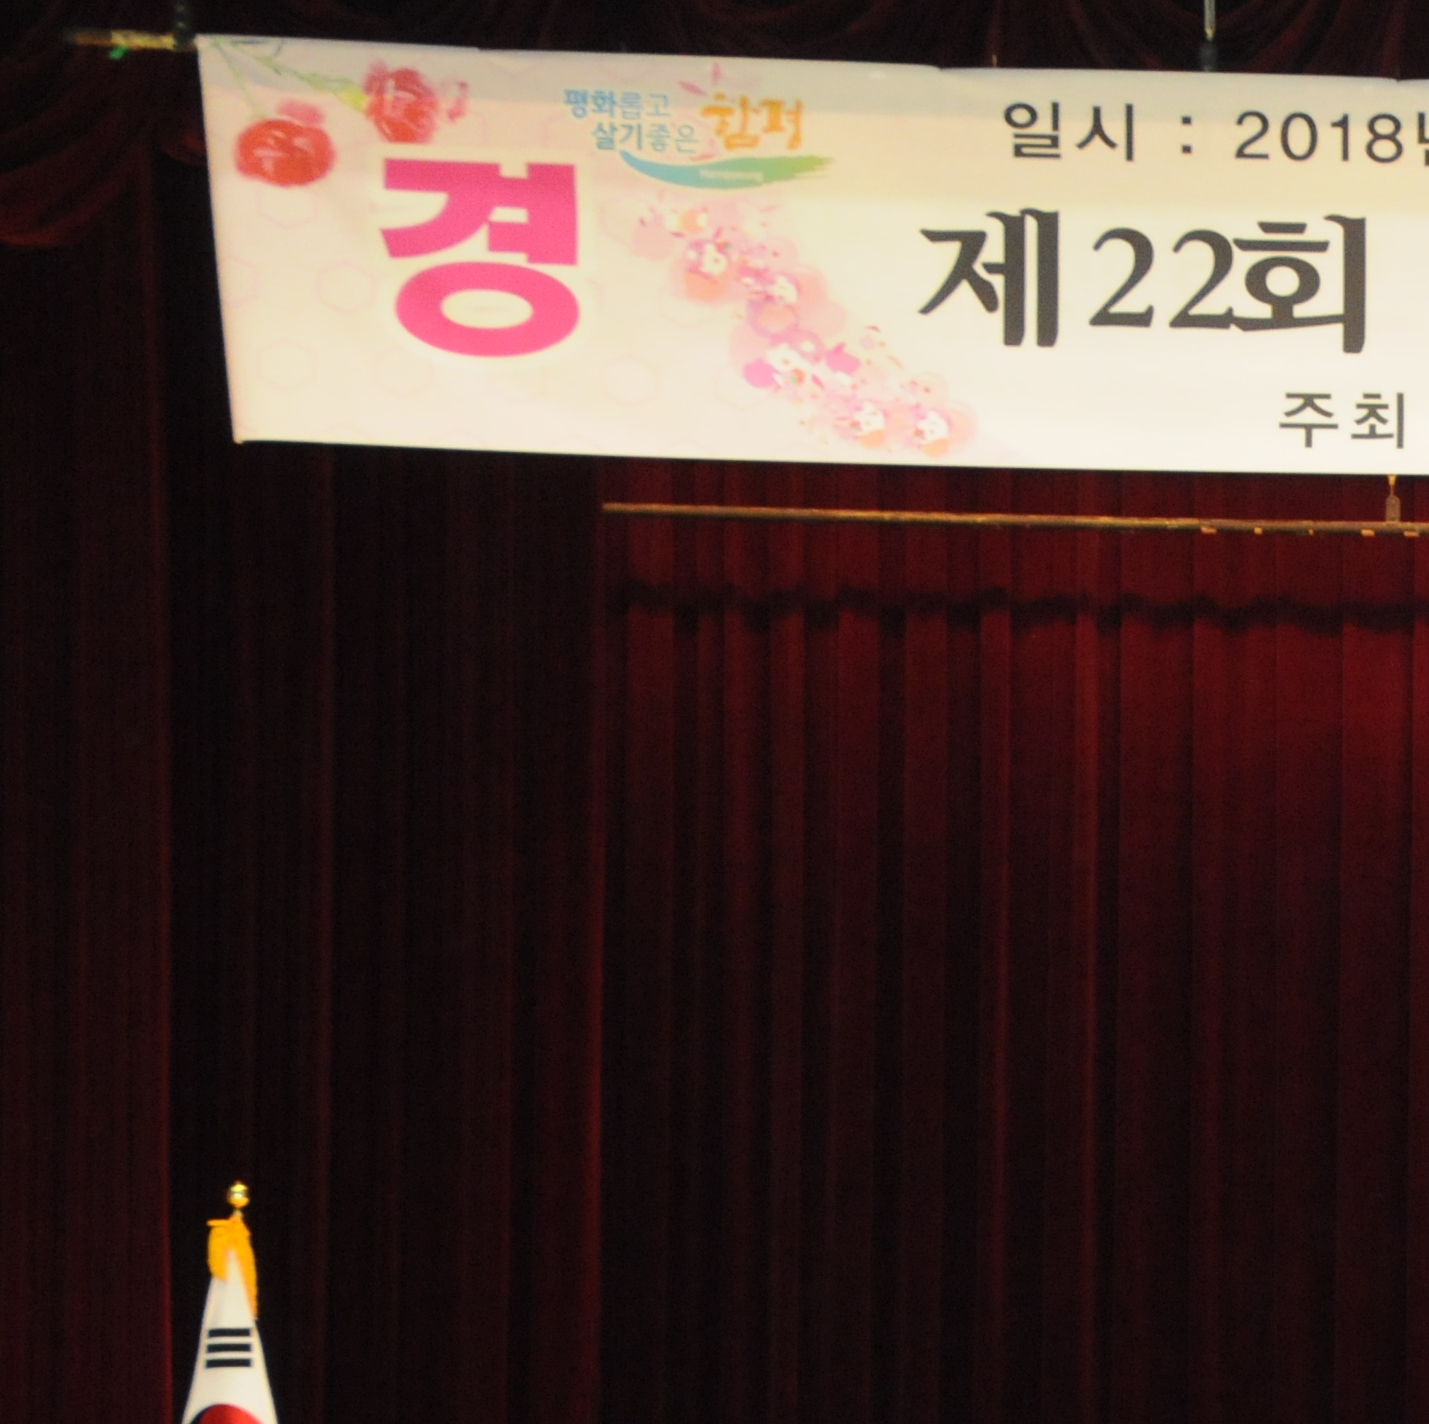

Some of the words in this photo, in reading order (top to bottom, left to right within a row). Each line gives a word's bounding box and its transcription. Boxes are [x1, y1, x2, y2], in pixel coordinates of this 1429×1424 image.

[564, 89, 671, 119] 평화롭고
[1004, 102, 1133, 161] 일시
[592, 122, 699, 153] 살기좋은
[382, 158, 578, 356] 경
[919, 208, 1366, 353] 제22회
[1280, 393, 1404, 448] 주최
